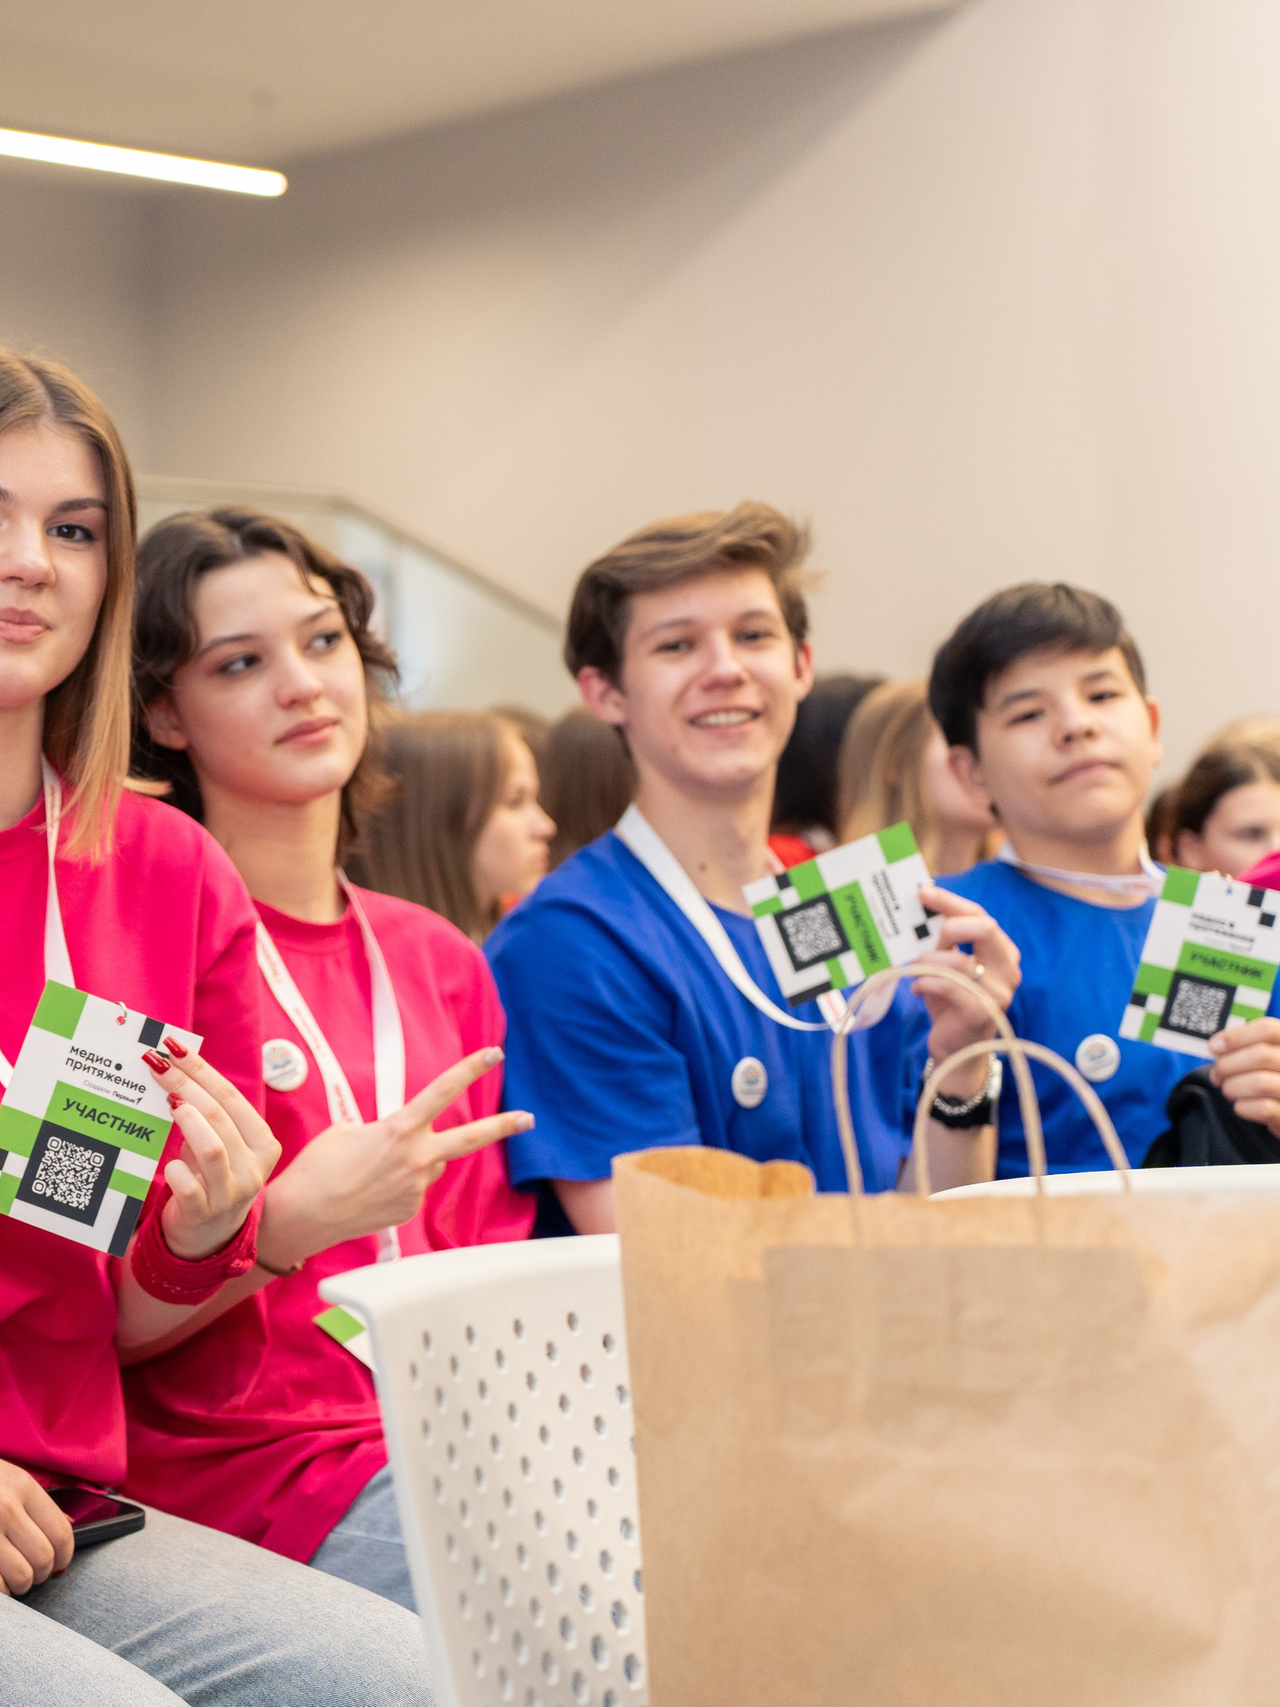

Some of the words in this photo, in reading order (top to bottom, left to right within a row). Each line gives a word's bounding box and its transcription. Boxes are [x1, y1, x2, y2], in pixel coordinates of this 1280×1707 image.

[69, 1045, 113, 1068] медиа
[65, 1057, 147, 1094] притяжение
[62, 1097, 156, 1143] УЧАСТНИК
